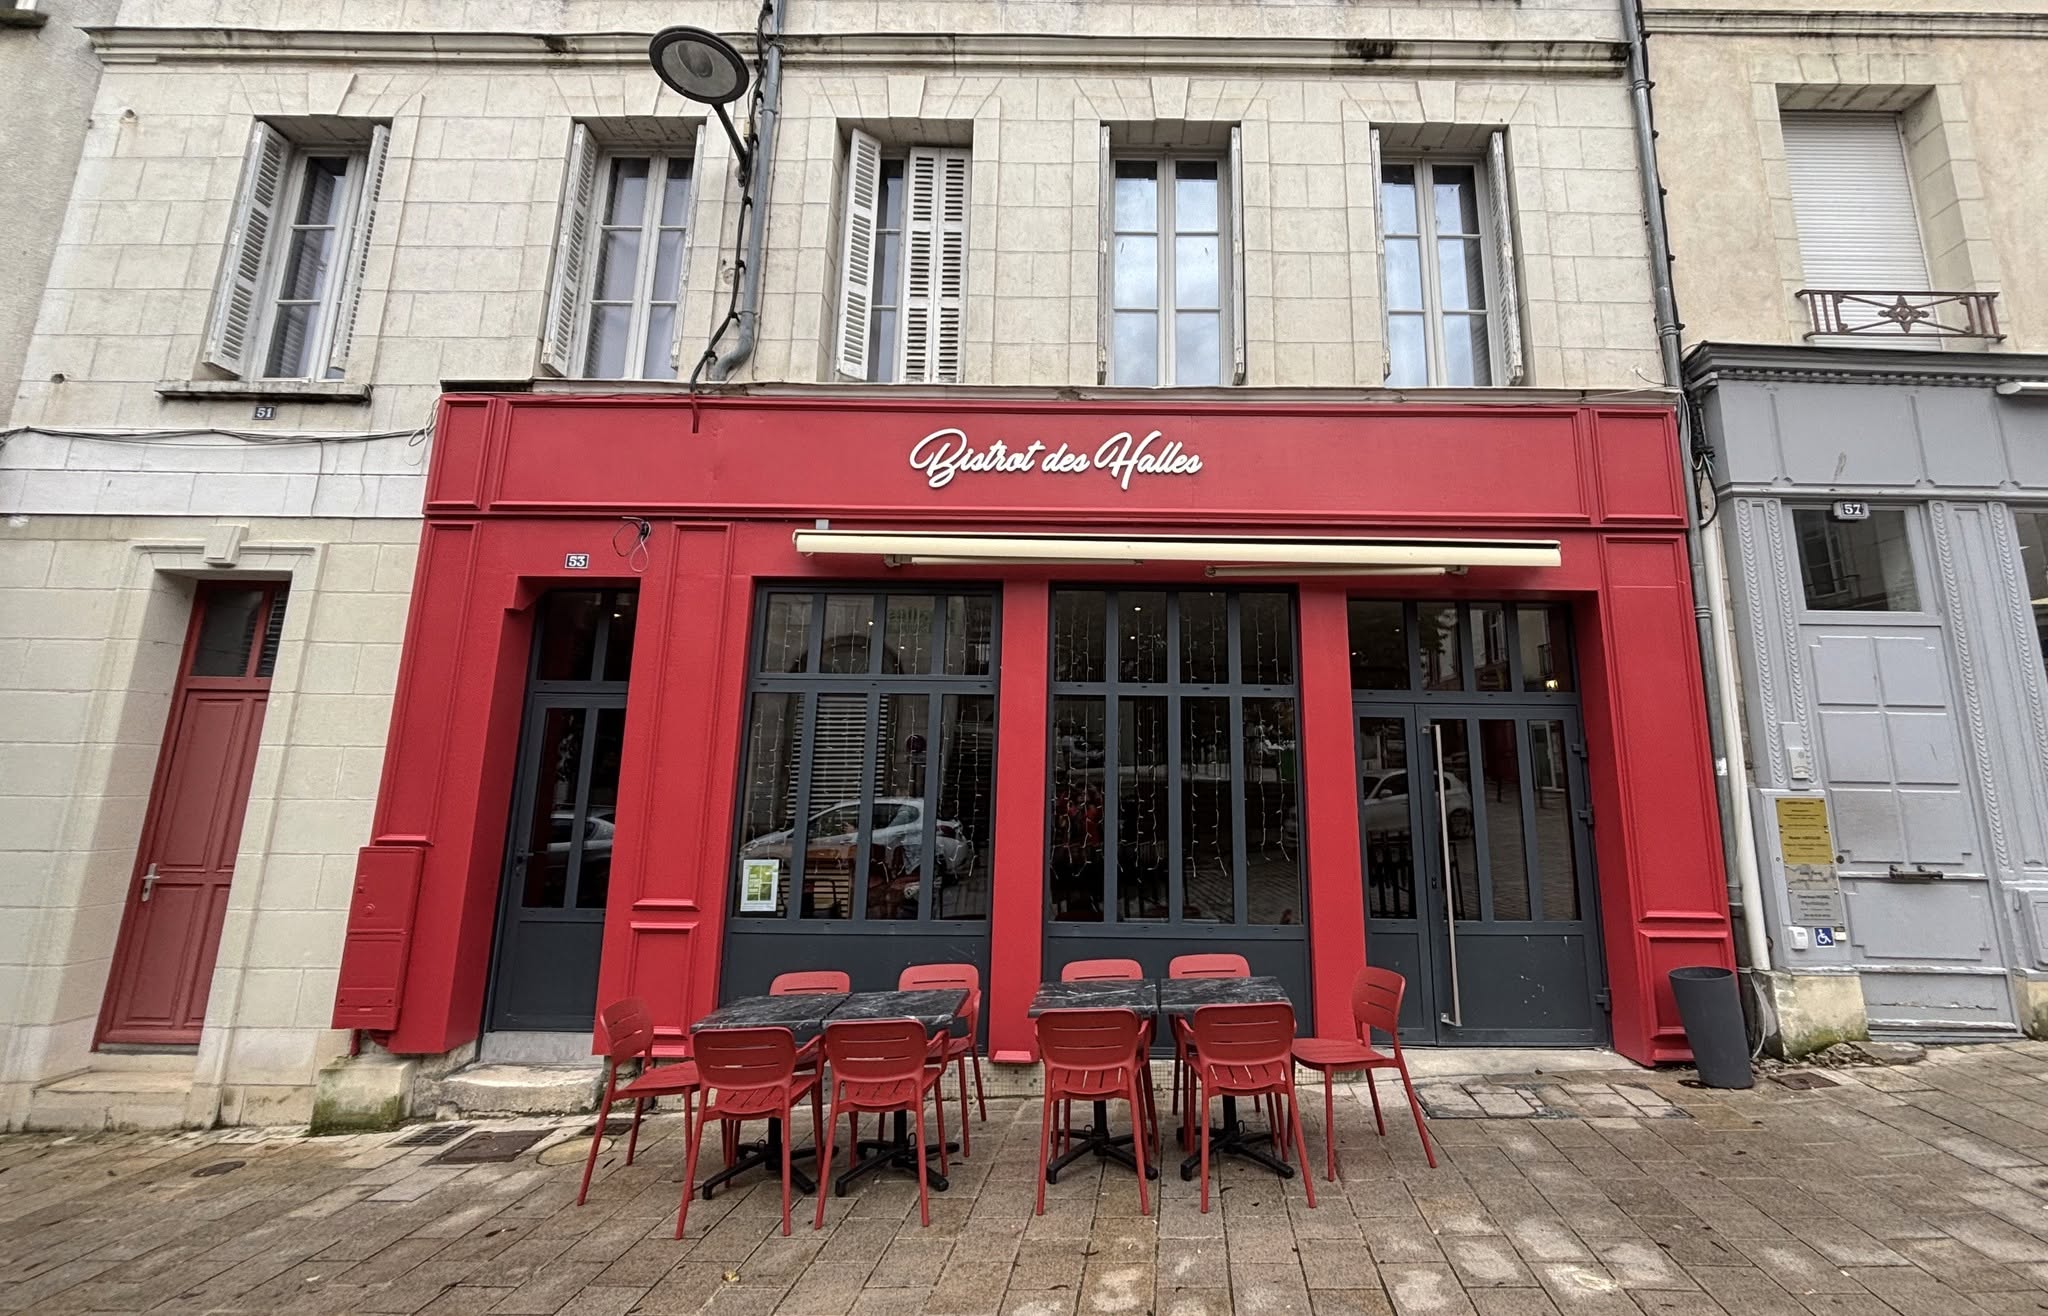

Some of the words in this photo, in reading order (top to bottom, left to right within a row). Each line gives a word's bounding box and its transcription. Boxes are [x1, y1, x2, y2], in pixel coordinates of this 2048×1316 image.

[256, 407, 272, 417] 51
[909, 428, 1046, 489] Bistrot
[1041, 443, 1090, 473] des
[1094, 430, 1203, 490] Halles
[1844, 504, 1862, 514] 57
[569, 555, 586, 567] 53
